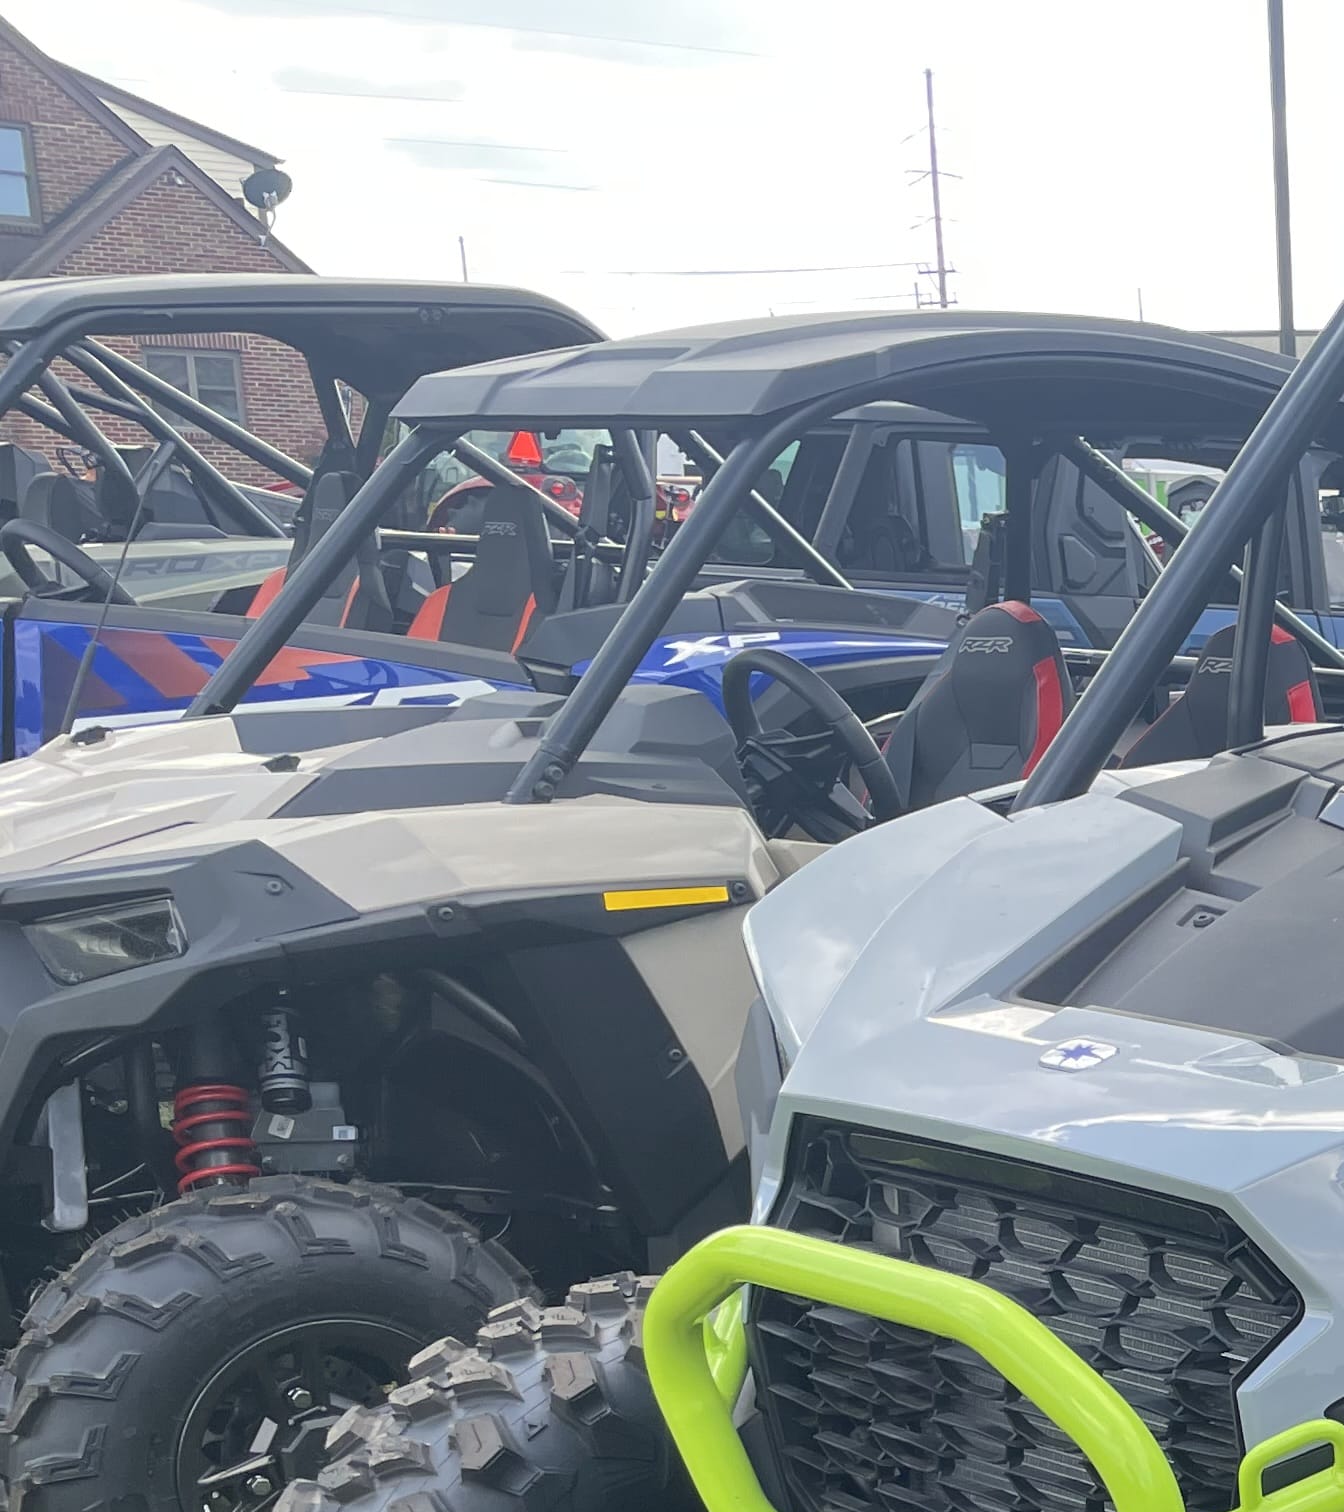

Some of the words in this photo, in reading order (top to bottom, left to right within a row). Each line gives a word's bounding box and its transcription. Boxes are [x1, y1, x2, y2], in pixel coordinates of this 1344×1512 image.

[663, 631, 781, 667] XP
[958, 635, 1014, 655] RZR
[1198, 656, 1233, 675] RZ
